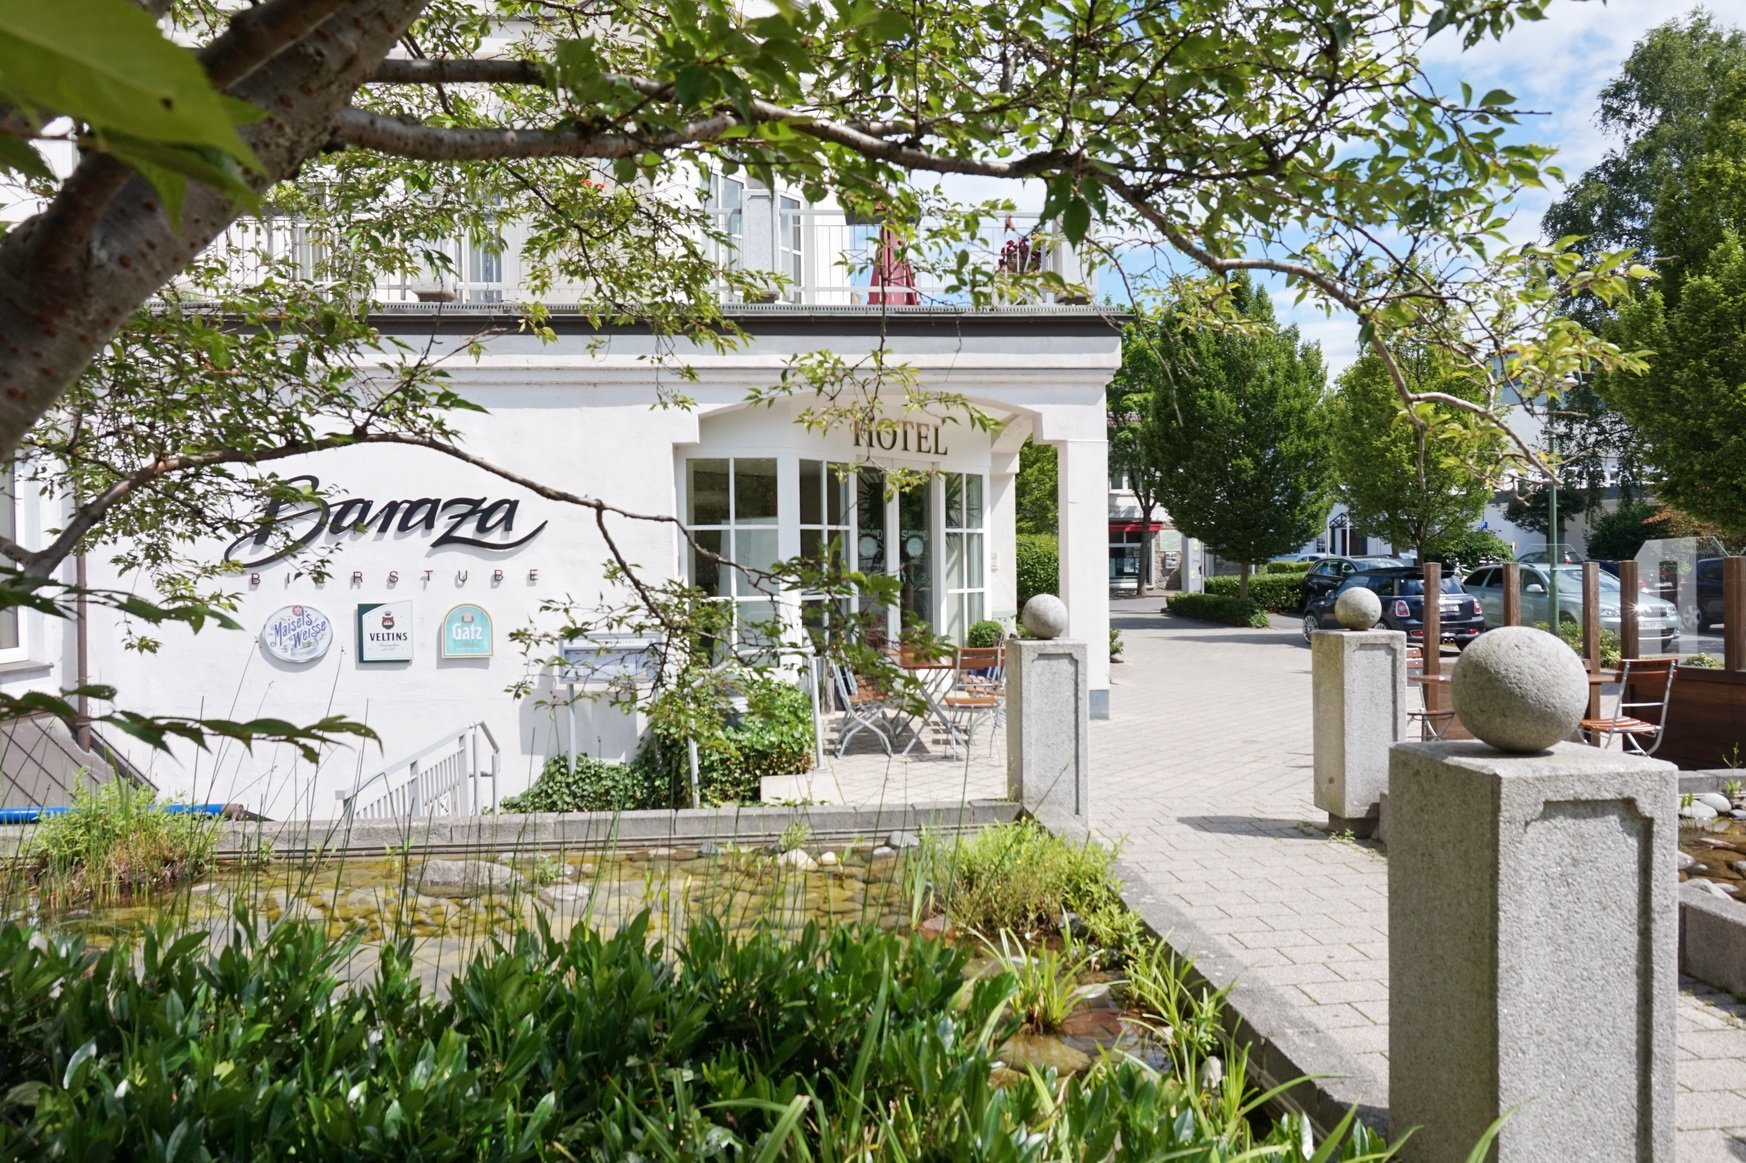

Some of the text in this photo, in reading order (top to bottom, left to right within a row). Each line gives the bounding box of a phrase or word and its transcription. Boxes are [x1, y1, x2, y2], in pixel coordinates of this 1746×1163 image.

[853, 418, 949, 456] HOTEL
[224, 475, 548, 568] Baraza
[250, 569, 540, 585] BIRSTUBE
[270, 609, 313, 648] Maisel's
[288, 620, 327, 649] Weisse
[369, 631, 408, 641] VELTINS
[452, 623, 483, 640] Gatz
